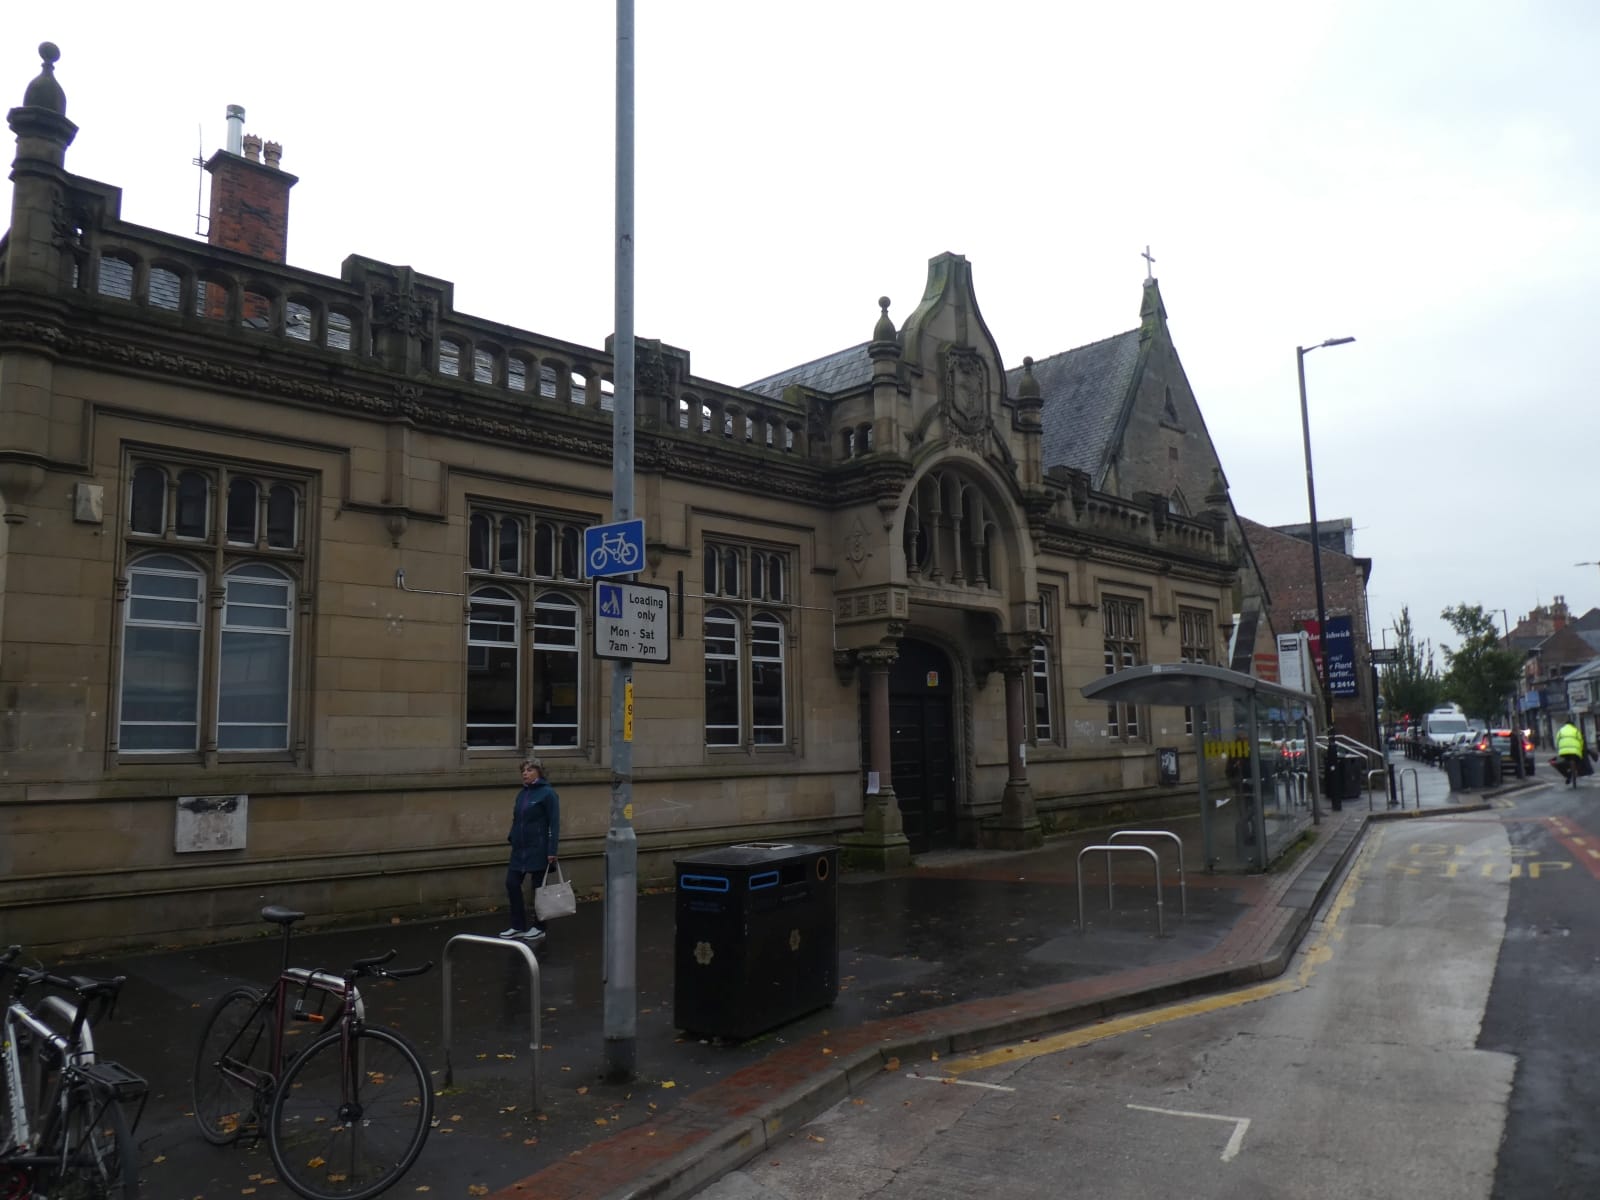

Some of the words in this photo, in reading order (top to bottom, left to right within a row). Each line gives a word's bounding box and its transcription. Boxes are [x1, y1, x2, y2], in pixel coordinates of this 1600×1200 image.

[629, 592, 664, 609] Loading
[637, 610, 656, 622] only
[610, 625, 630, 637] Mon
[639, 628, 655, 640] Sat
[609, 640, 628, 652] 7am
[637, 642, 657, 655] 7pm
[1409, 842, 1540, 857] BUS
[1386, 861, 1573, 878] STOP
